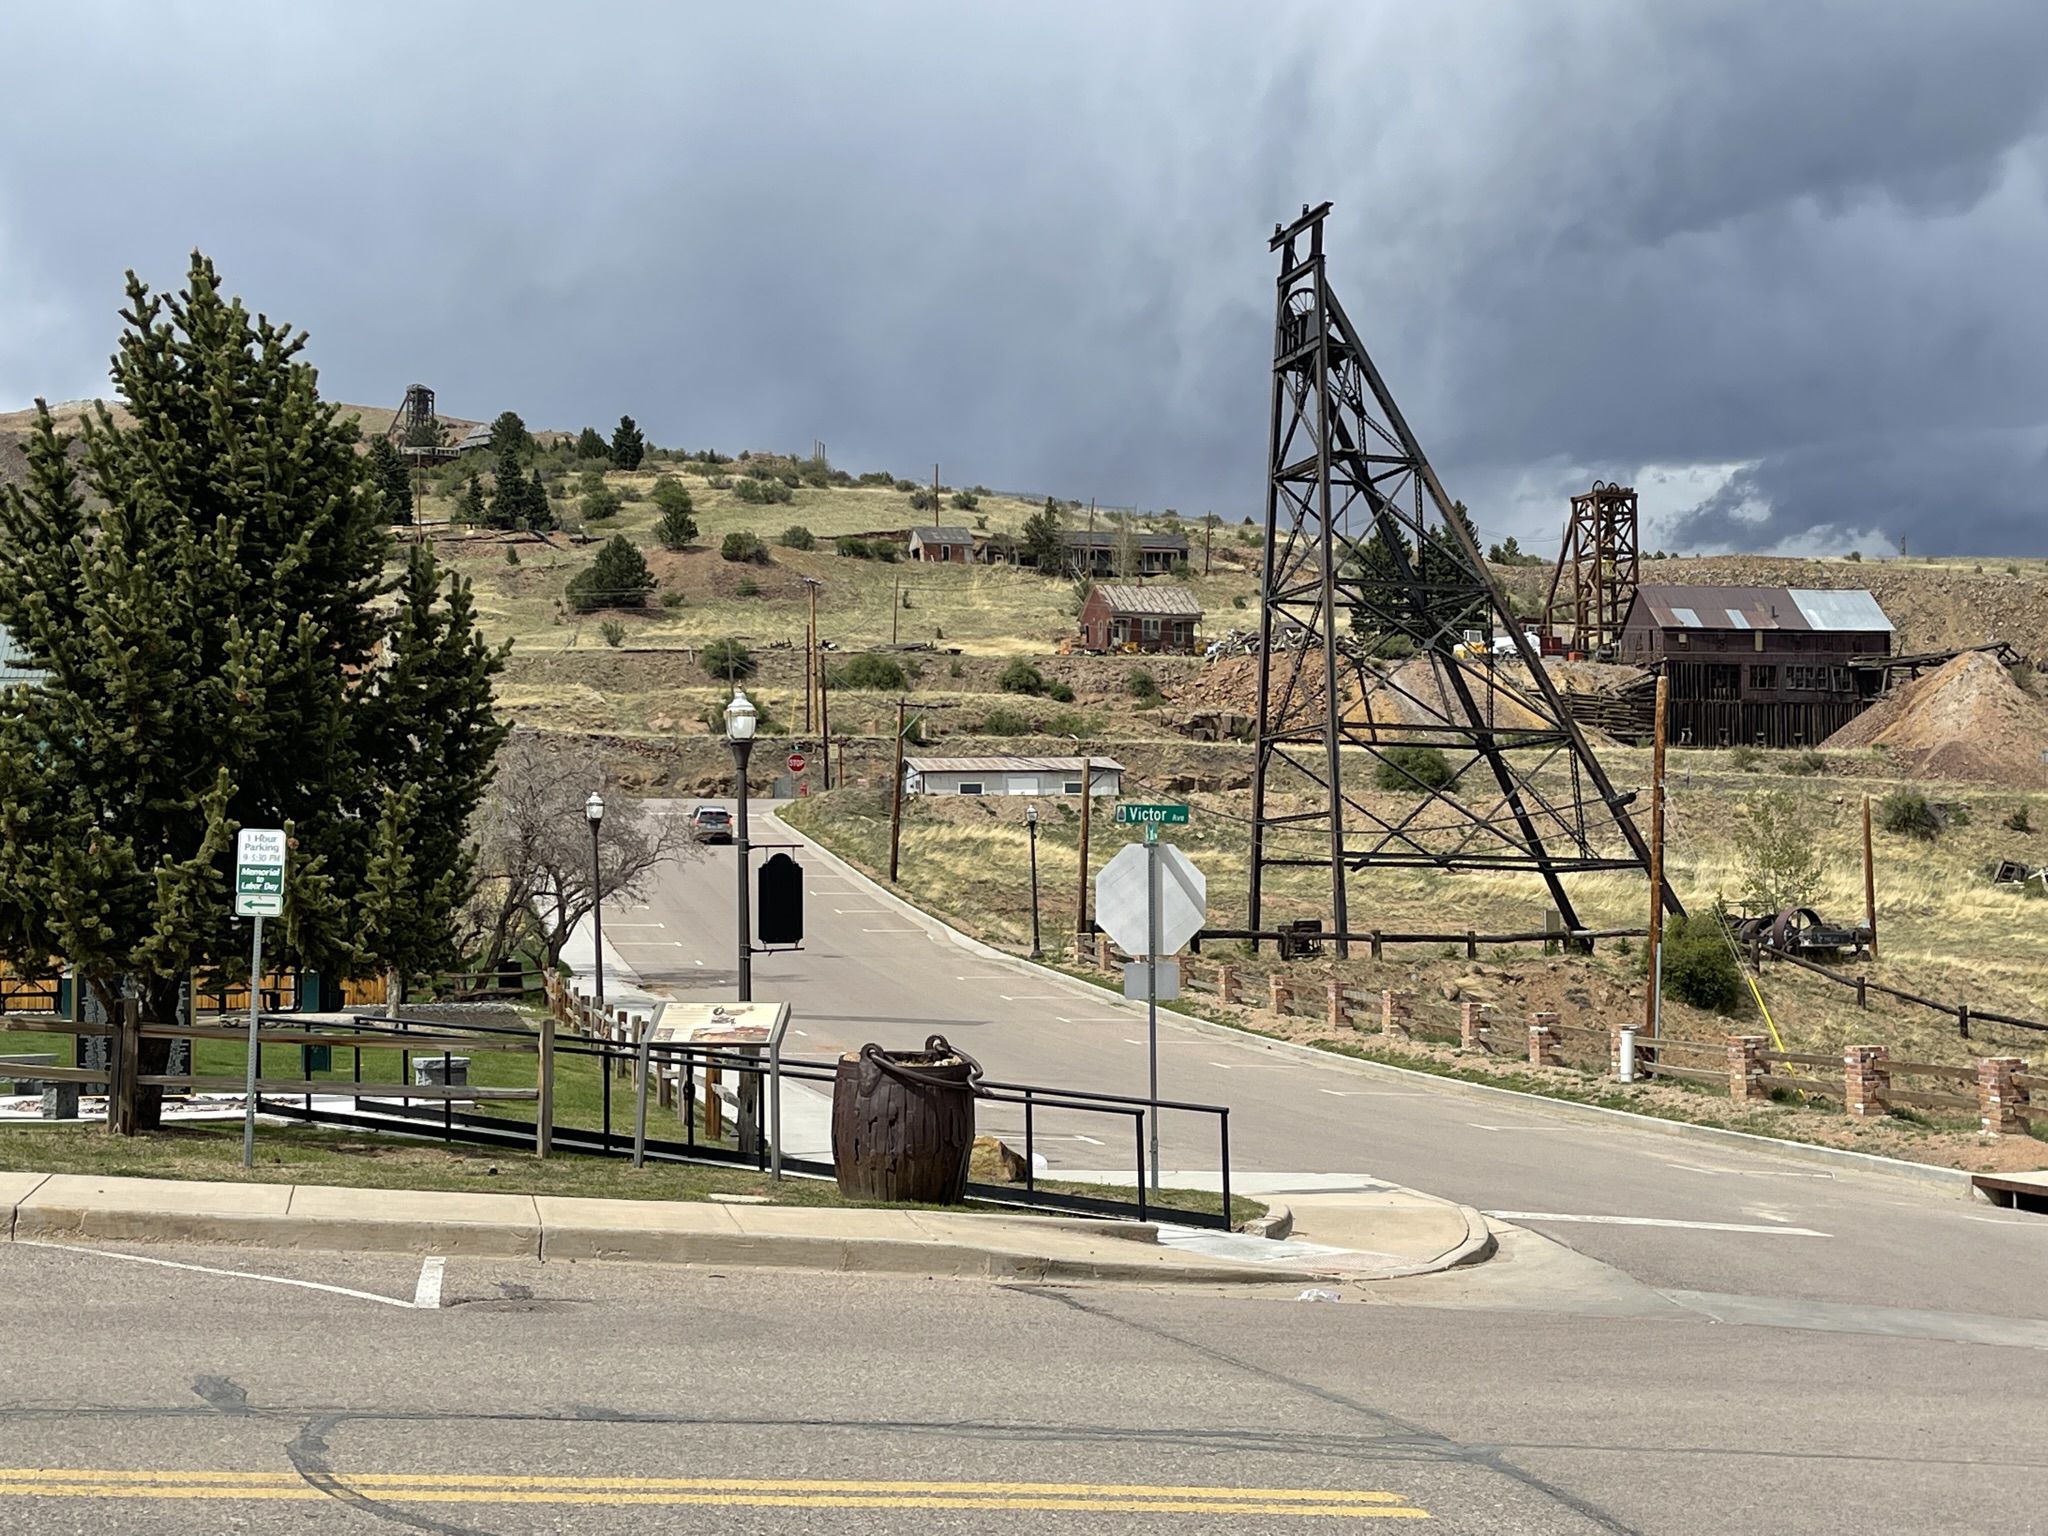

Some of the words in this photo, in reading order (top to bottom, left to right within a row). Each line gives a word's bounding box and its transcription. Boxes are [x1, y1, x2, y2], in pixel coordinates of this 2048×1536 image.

[789, 759, 805, 767] STOP
[1129, 806, 1167, 821] Victor
[1172, 813, 1185, 822] Ave
[254, 834, 278, 843] Hour
[244, 842, 280, 853] Parking
[241, 867, 280, 876] Memorial
[241, 881, 263, 890] Labor
[264, 882, 279, 892] Day
